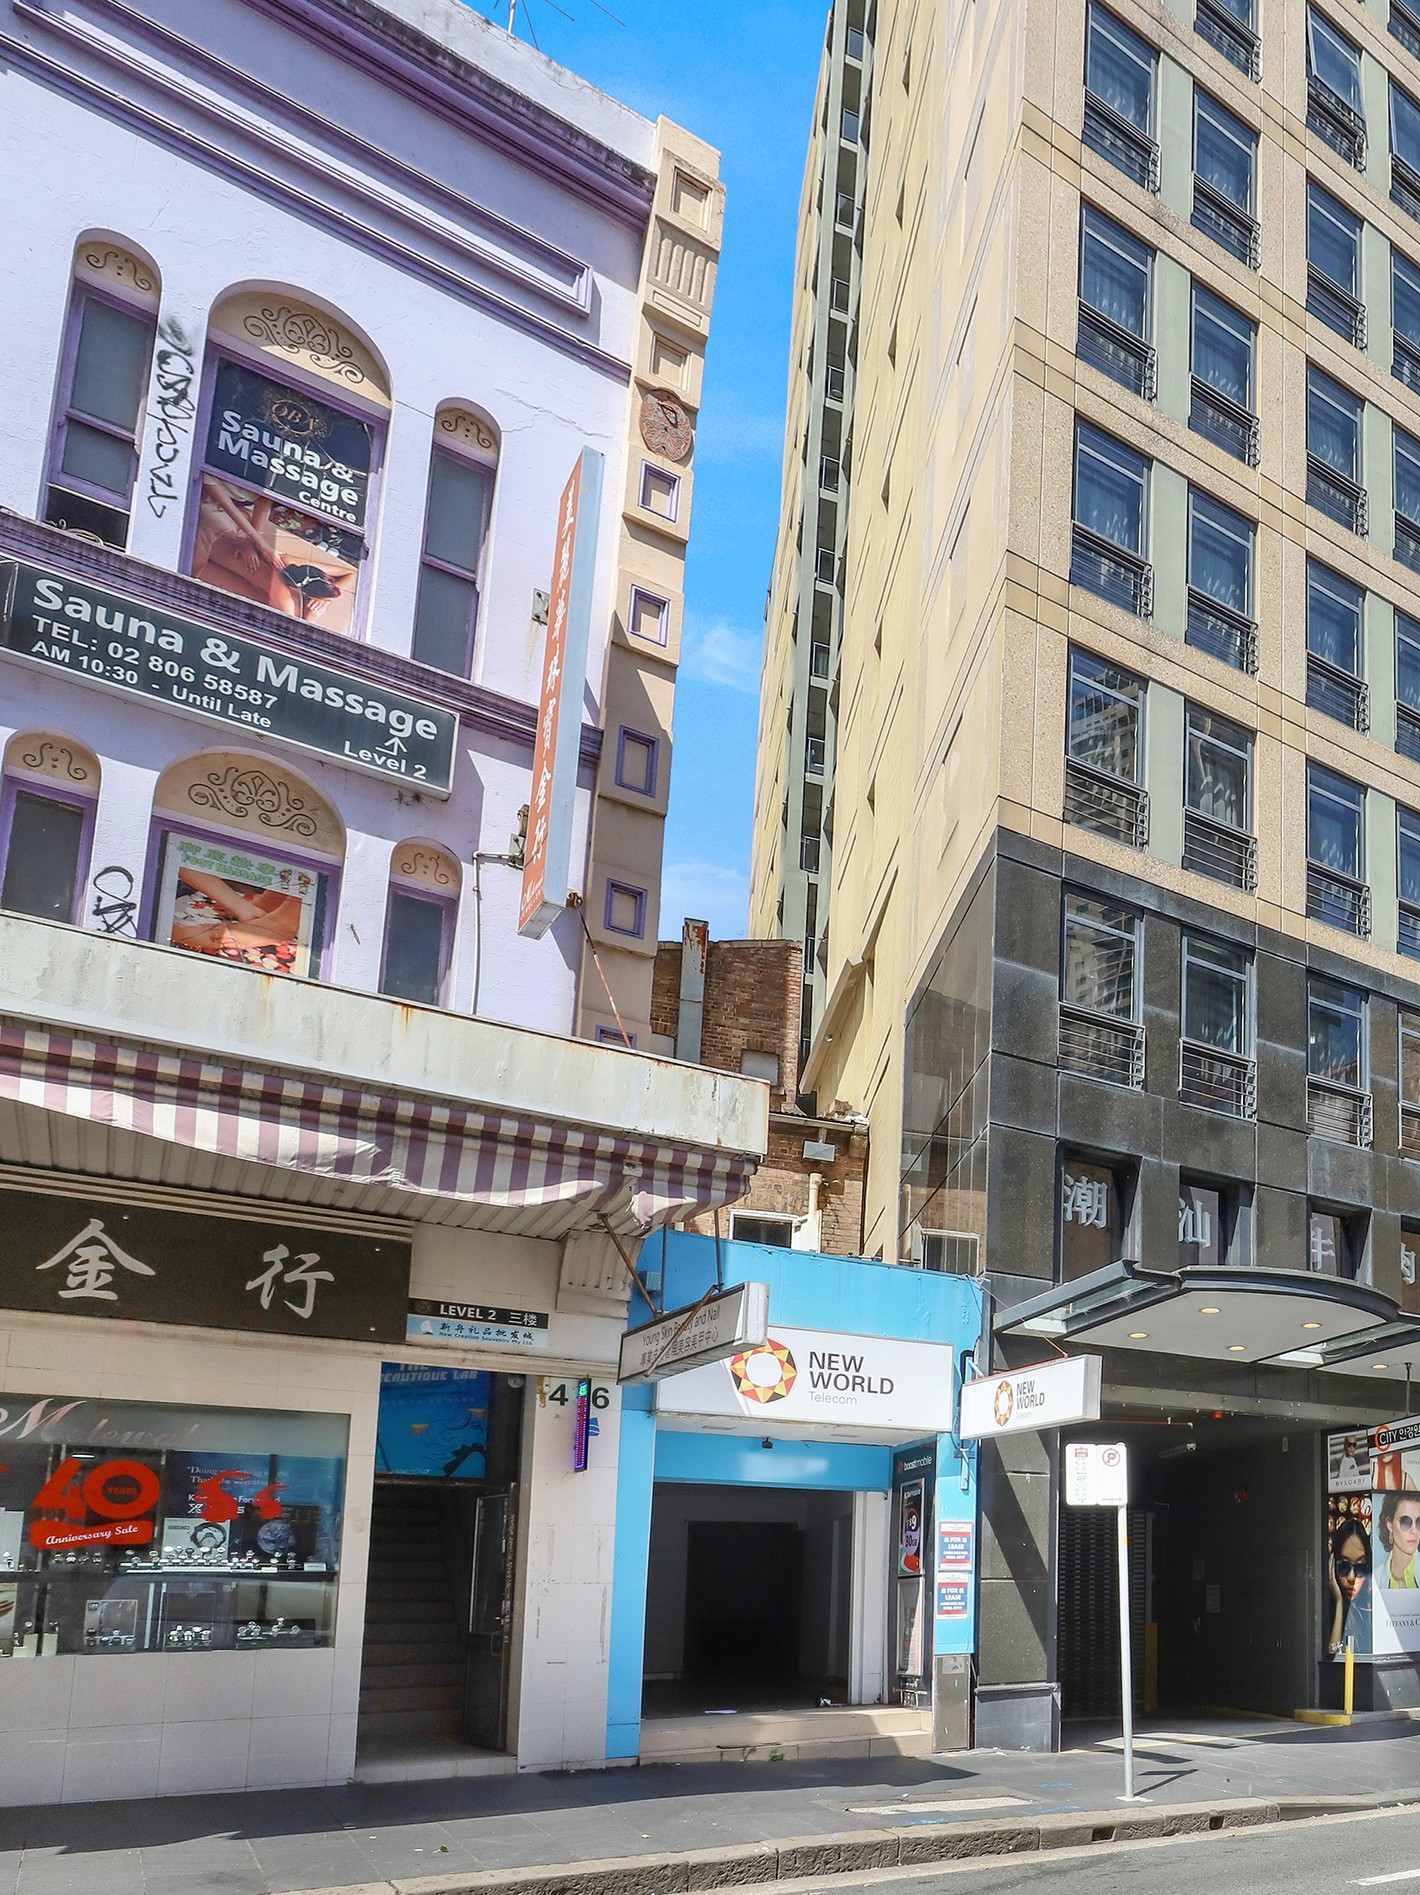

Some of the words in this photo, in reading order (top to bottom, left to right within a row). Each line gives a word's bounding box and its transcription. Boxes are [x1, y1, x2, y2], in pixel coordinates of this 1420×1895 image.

[222, 409, 322, 469] Sauna
[332, 462, 354, 483] &
[218, 431, 359, 506] Massage
[299, 491, 357, 523] Centre
[32, 614, 98, 651] TEL:
[108, 641, 141, 665] 02
[148, 656, 196, 683] 806
[203, 674, 278, 710] 58587
[33, 578, 184, 654] Sauna
[200, 637, 241, 674] &
[256, 654, 438, 740] Massage
[31, 640, 71, 663] AM
[78, 655, 139, 685] 10:30
[172, 684, 221, 712] Until
[227, 703, 272, 728] Late
[343, 740, 406, 773] Level
[413, 764, 428, 780] 2
[36, 1218, 335, 1318] 金行
[440, 1304, 484, 1319] LEVEL
[488, 1310, 497, 1321] 2
[508, 1311, 538, 1327] 三楼
[642, 1329, 660, 1347] Young
[809, 1351, 864, 1372] NEW
[453, 1370, 478, 1380] LAB
[809, 1371, 894, 1395] WORLD
[808, 1391, 858, 1405] Telecom
[1016, 1380, 1036, 1396] NEW
[1016, 1392, 1045, 1411] WORLD
[1379, 1430, 1398, 1446] CITY
[33, 1458, 161, 1520] 40
[45, 1531, 113, 1546] Anniversary
[115, 1524, 139, 1535] Sale
